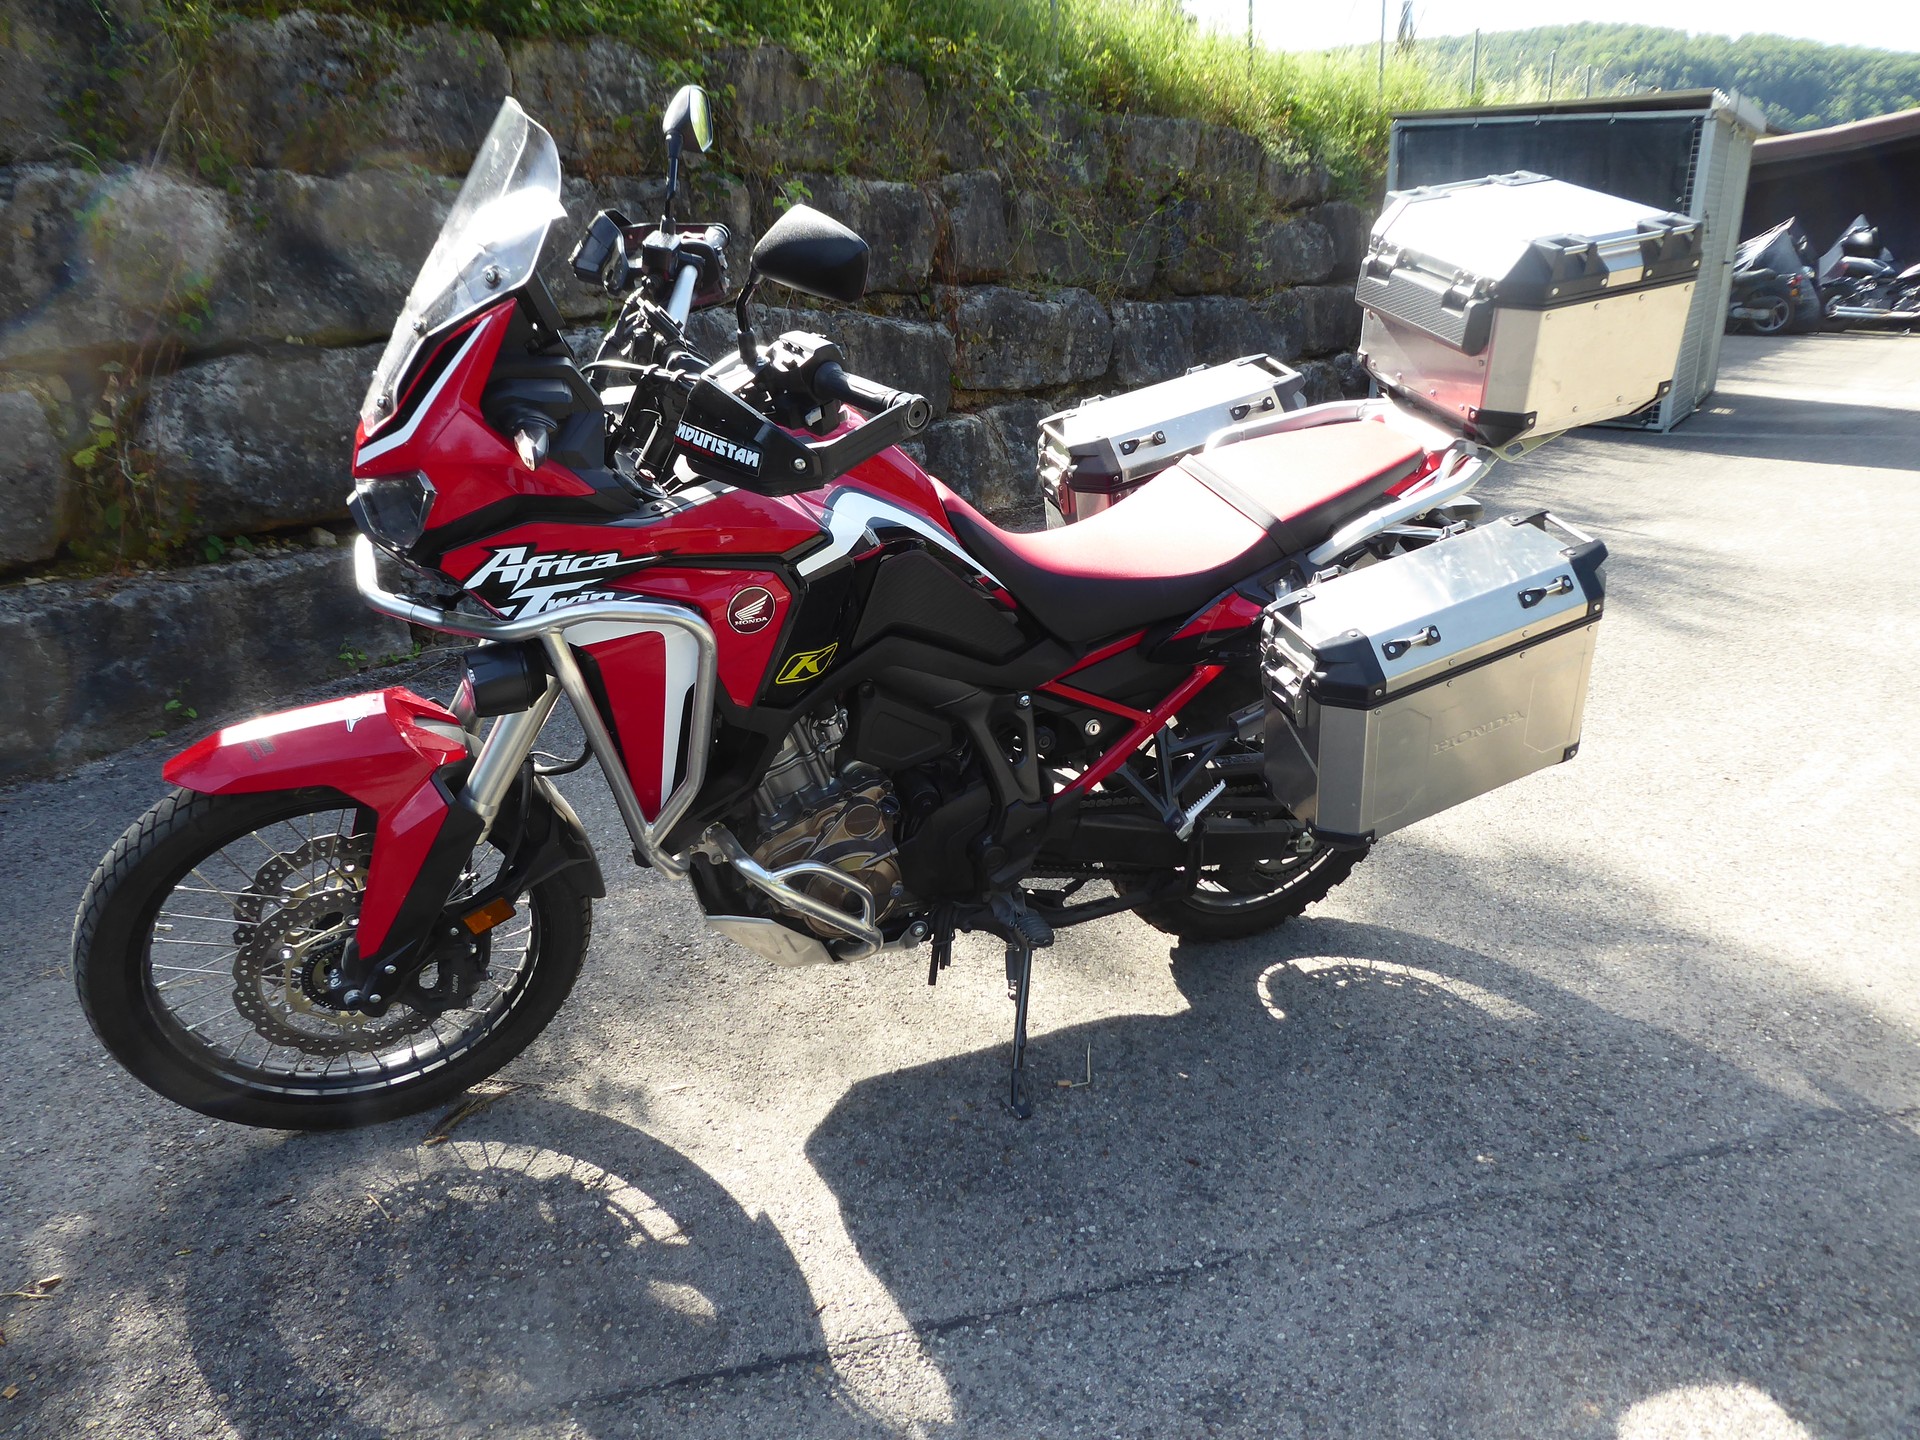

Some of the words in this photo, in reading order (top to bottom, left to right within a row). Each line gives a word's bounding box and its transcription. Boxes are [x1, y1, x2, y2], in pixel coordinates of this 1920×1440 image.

[675, 423, 760, 468] NDURISTAN
[464, 546, 658, 593] Africa
[735, 616, 768, 626] HONDA
[1433, 710, 1525, 755] HONDA
